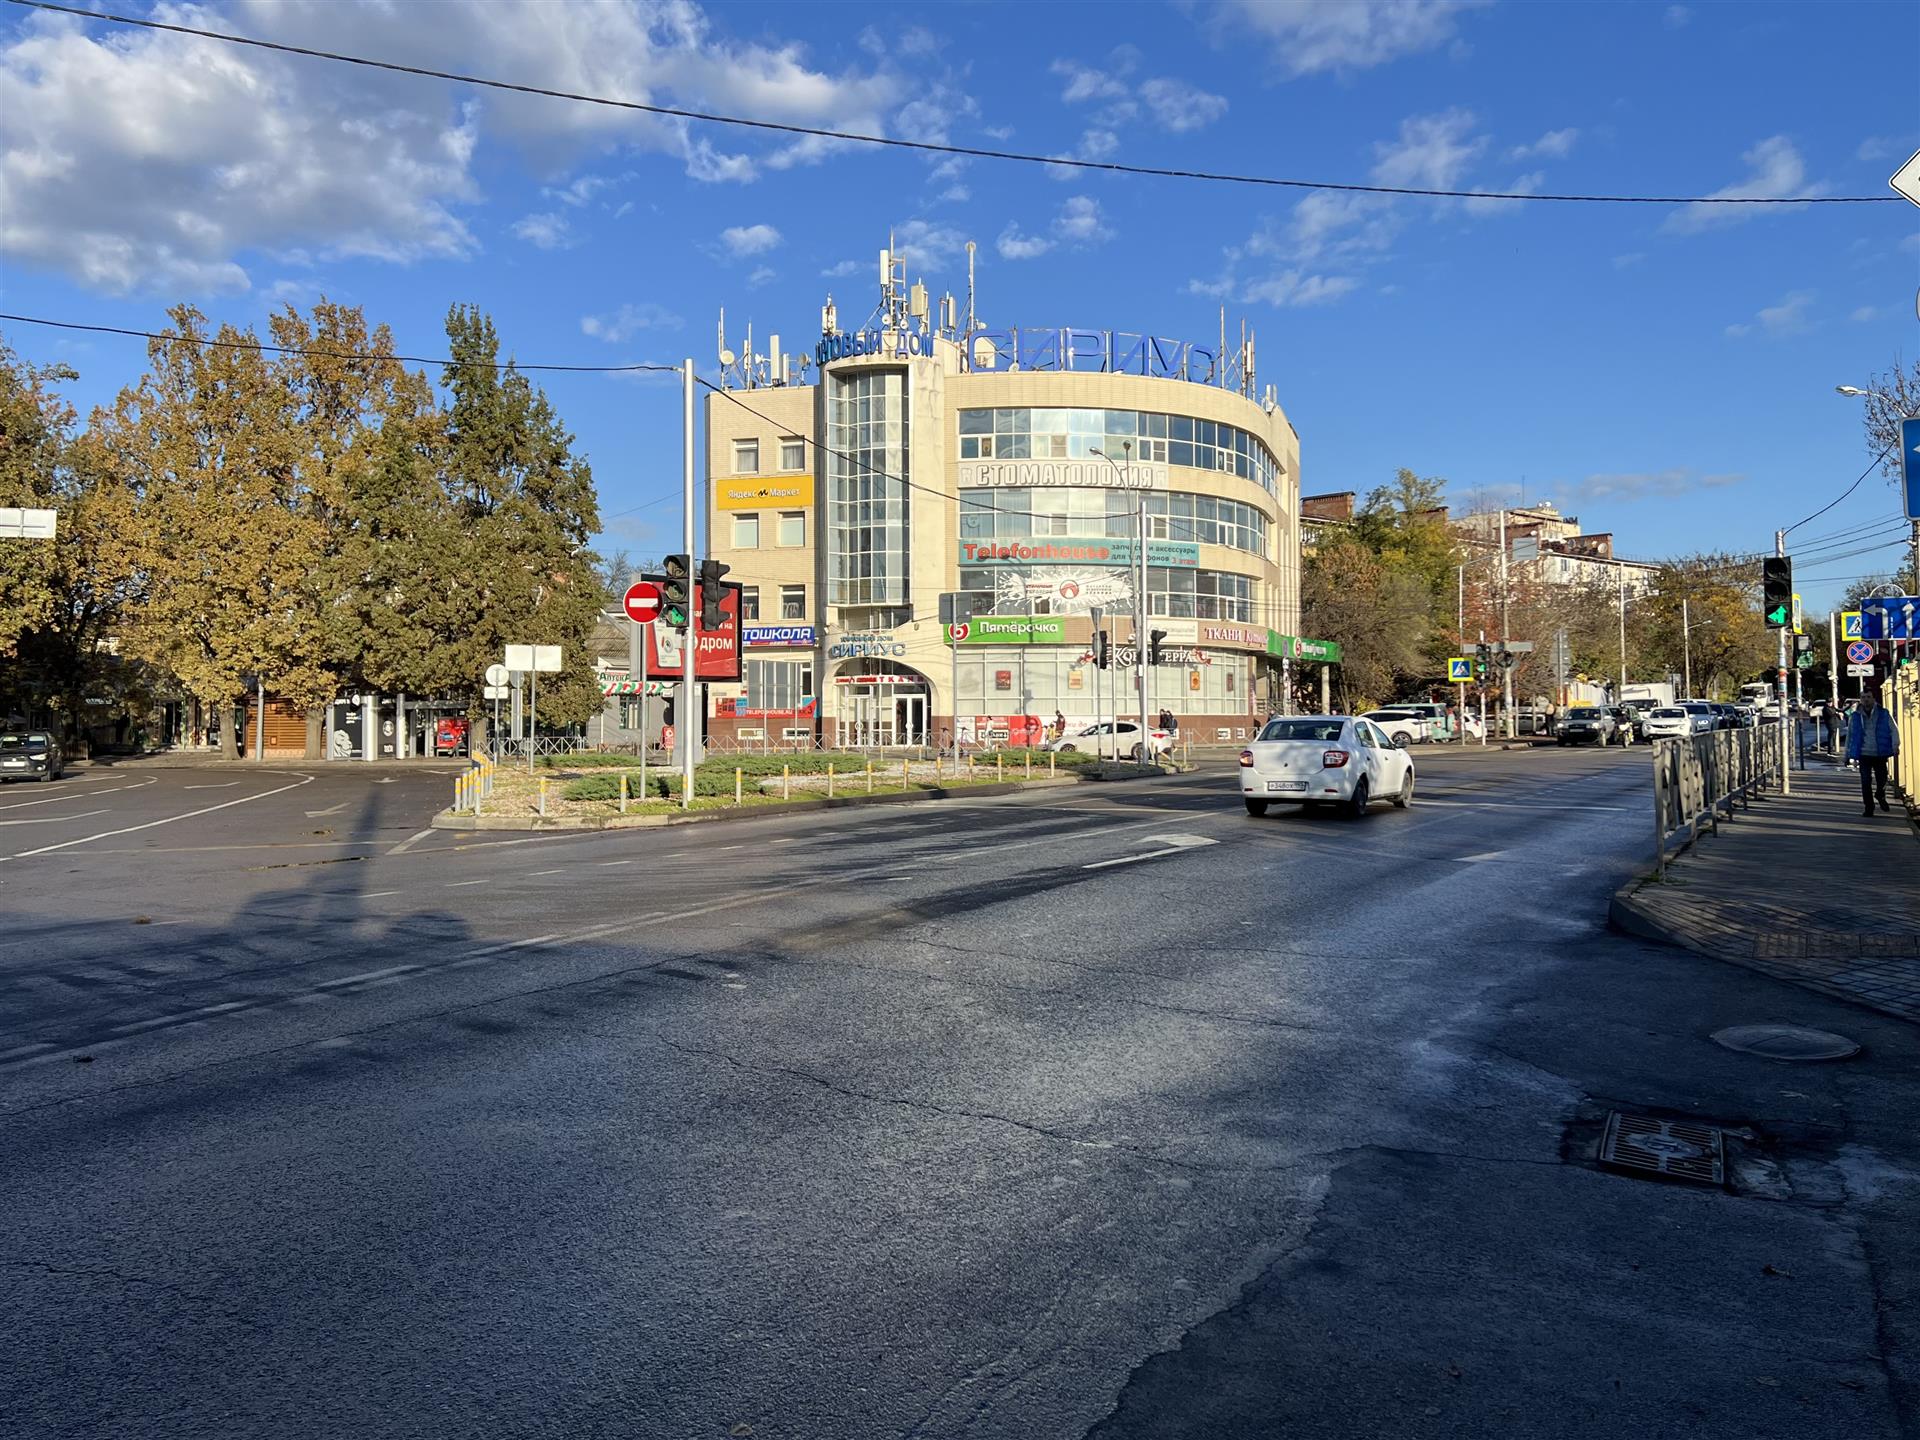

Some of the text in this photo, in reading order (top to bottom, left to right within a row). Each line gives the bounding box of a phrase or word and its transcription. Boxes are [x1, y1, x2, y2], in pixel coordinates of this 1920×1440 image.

[895, 330, 934, 359] ДОМ
[976, 464, 1153, 487] СТОМАТОЛОГИЯ
[728, 487, 800, 499] Яндекс Маркет
[963, 542, 1109, 561] Telefonhouse
[1155, 546, 1196, 555] аксессуары
[979, 620, 1059, 635] Пятёрочка
[1204, 627, 1242, 642] ТКАНИ
[700, 636, 733, 654] дром
[831, 642, 906, 658] СИРИУС
